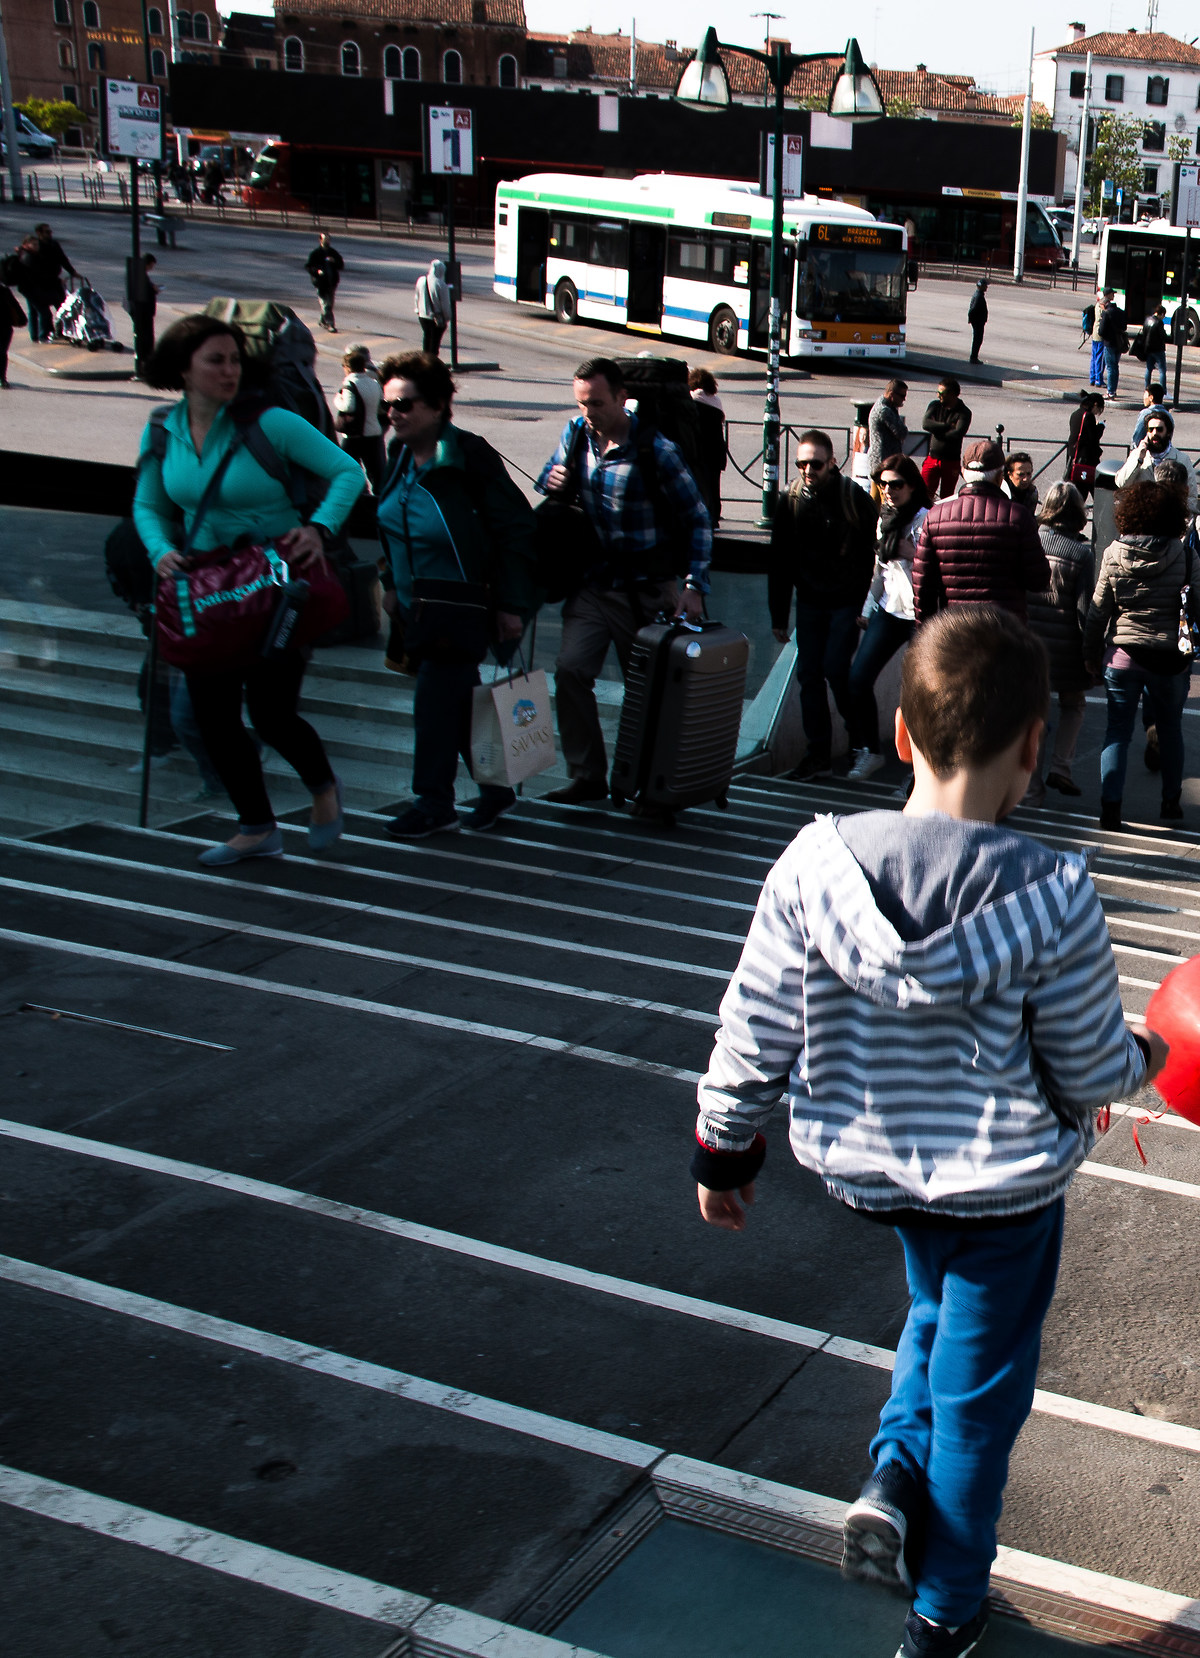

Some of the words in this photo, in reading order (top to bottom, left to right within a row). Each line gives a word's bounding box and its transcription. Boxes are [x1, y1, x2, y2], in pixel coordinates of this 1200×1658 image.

[87, 31, 118, 43] HOTEL
[142, 91, 157, 103] A1
[456, 114, 469, 125] A2
[789, 141, 800, 150] A3
[817, 225, 830, 241] 6L
[193, 573, 275, 614] patagonia
